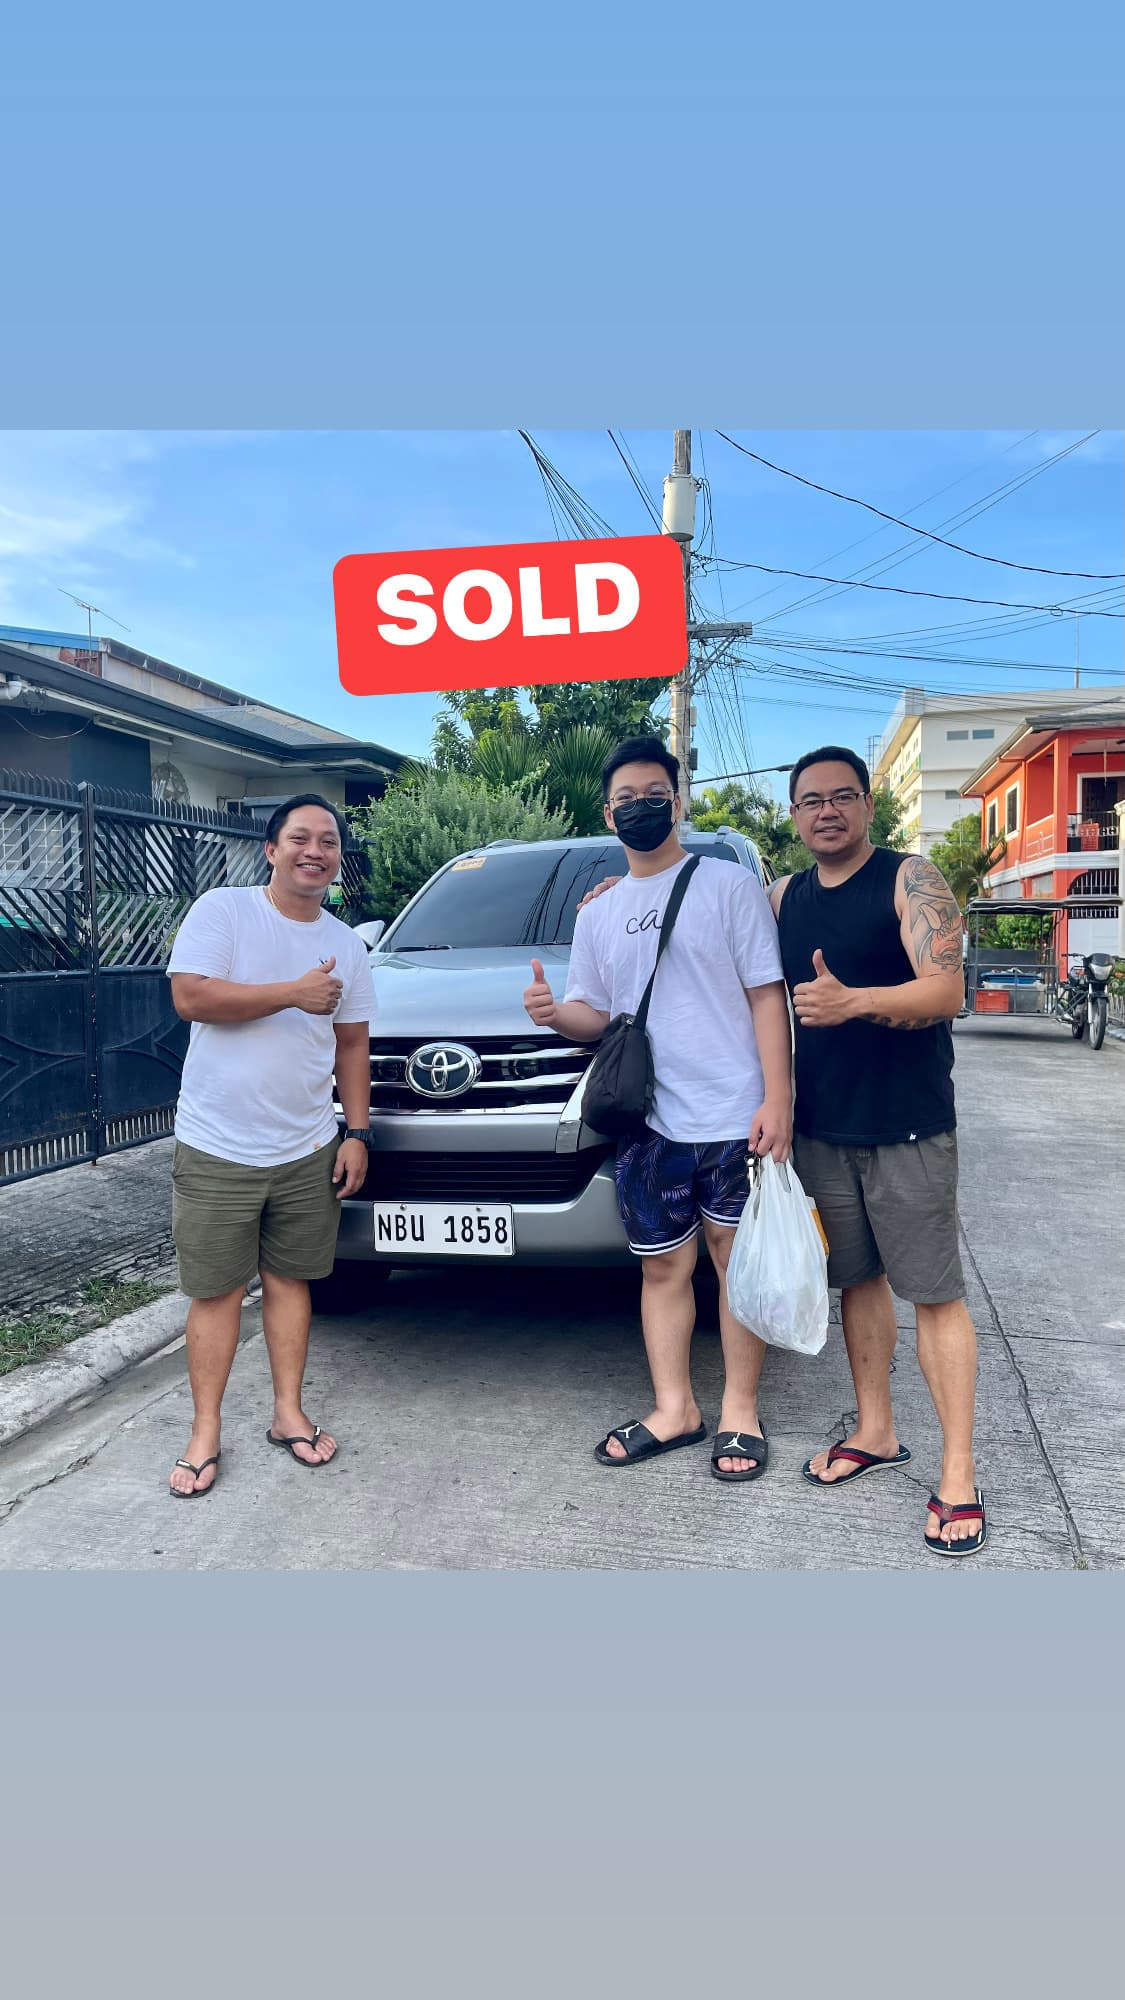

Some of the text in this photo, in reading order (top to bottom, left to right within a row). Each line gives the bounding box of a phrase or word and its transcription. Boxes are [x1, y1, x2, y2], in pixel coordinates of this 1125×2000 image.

[626, 909, 663, 934] ca
[378, 1214, 508, 1243] NBU 1858
